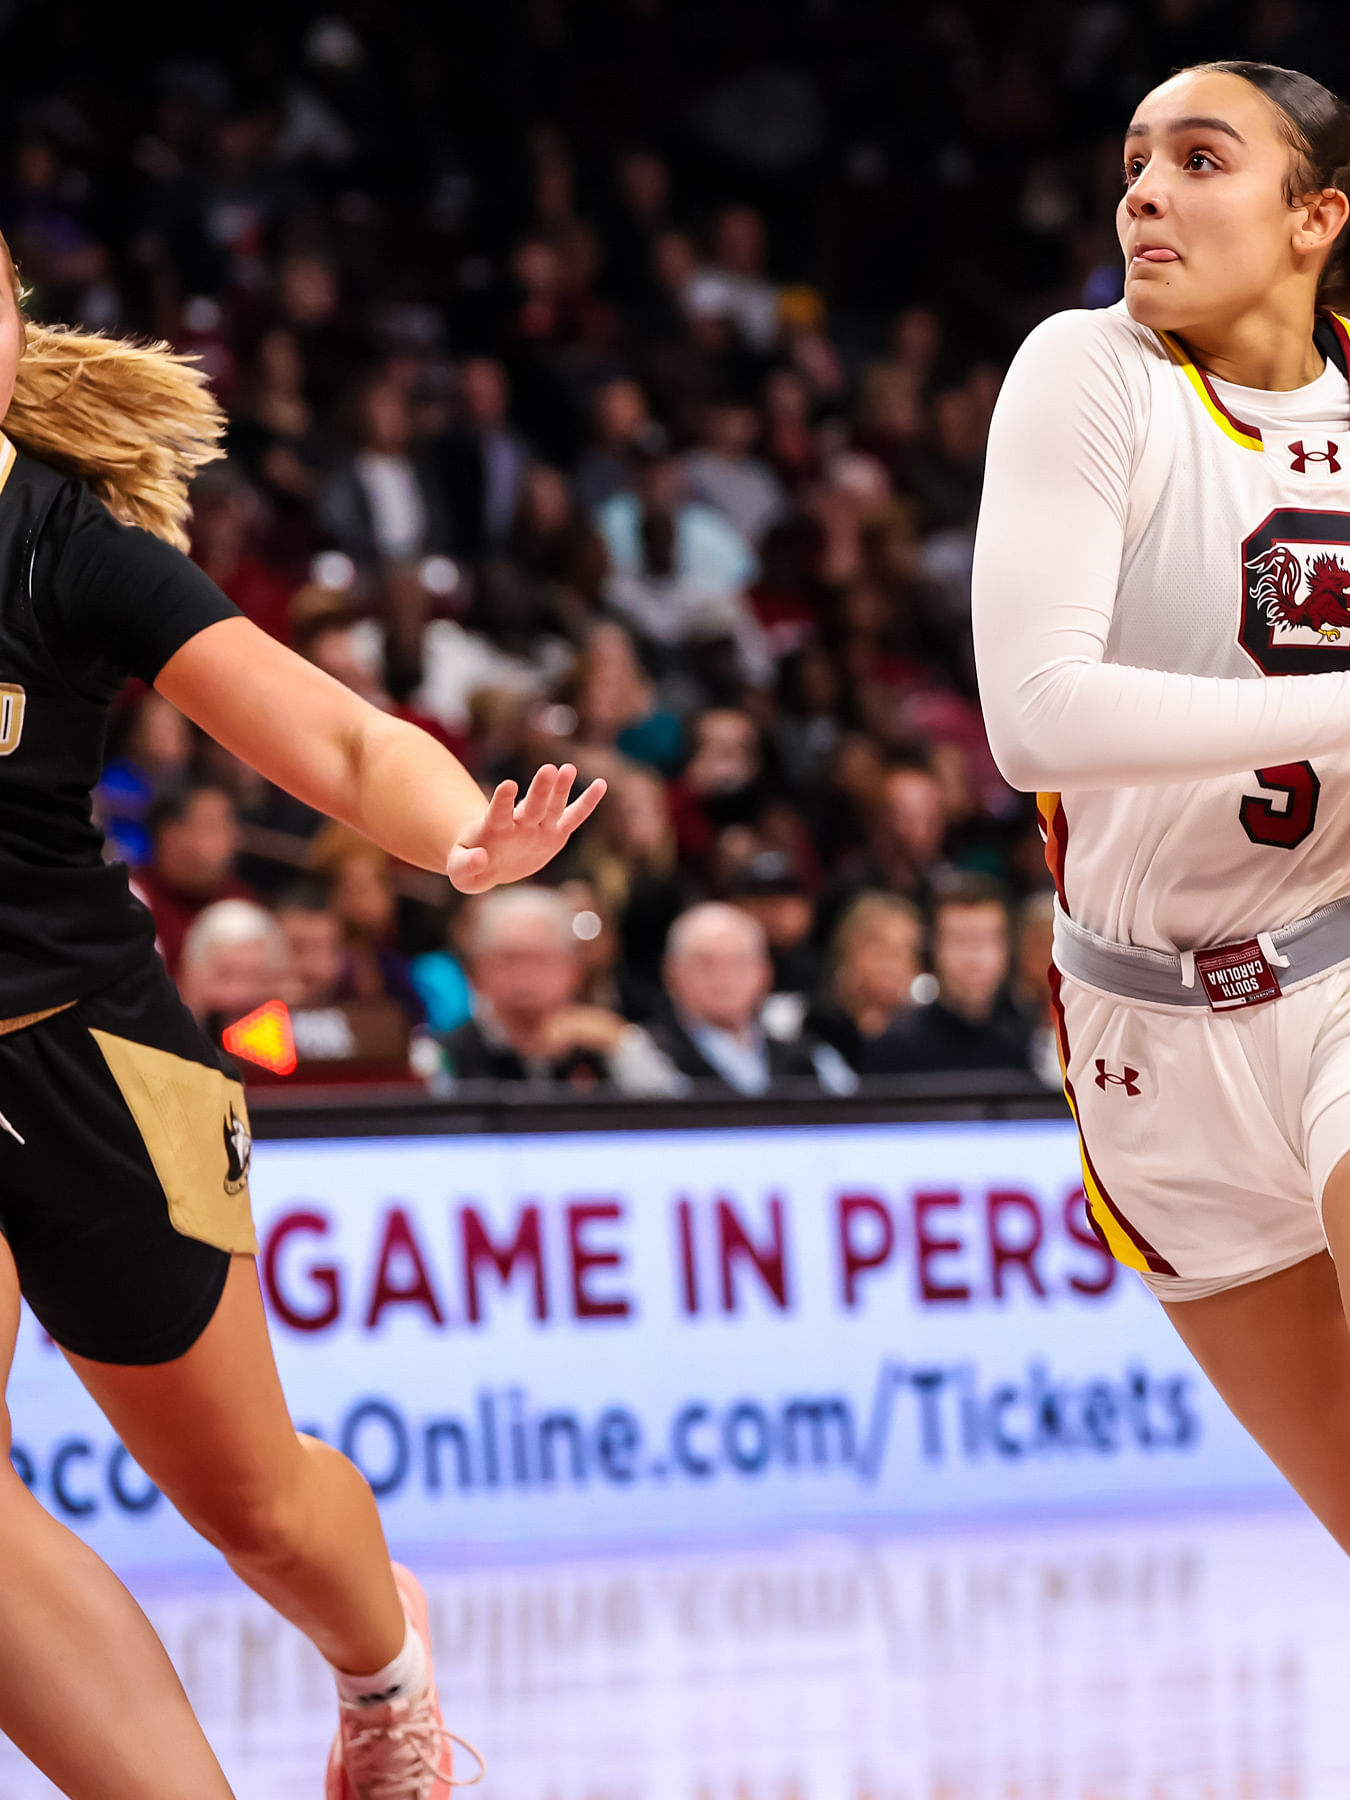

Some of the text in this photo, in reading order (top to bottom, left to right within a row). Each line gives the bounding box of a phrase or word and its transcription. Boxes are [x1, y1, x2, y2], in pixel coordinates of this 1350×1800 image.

[1207, 960, 1264, 985] CAROLINA
[1221, 977, 1260, 997] SOUTH
[264, 1202, 630, 1332] GAME
[679, 1192, 790, 1314] IN
